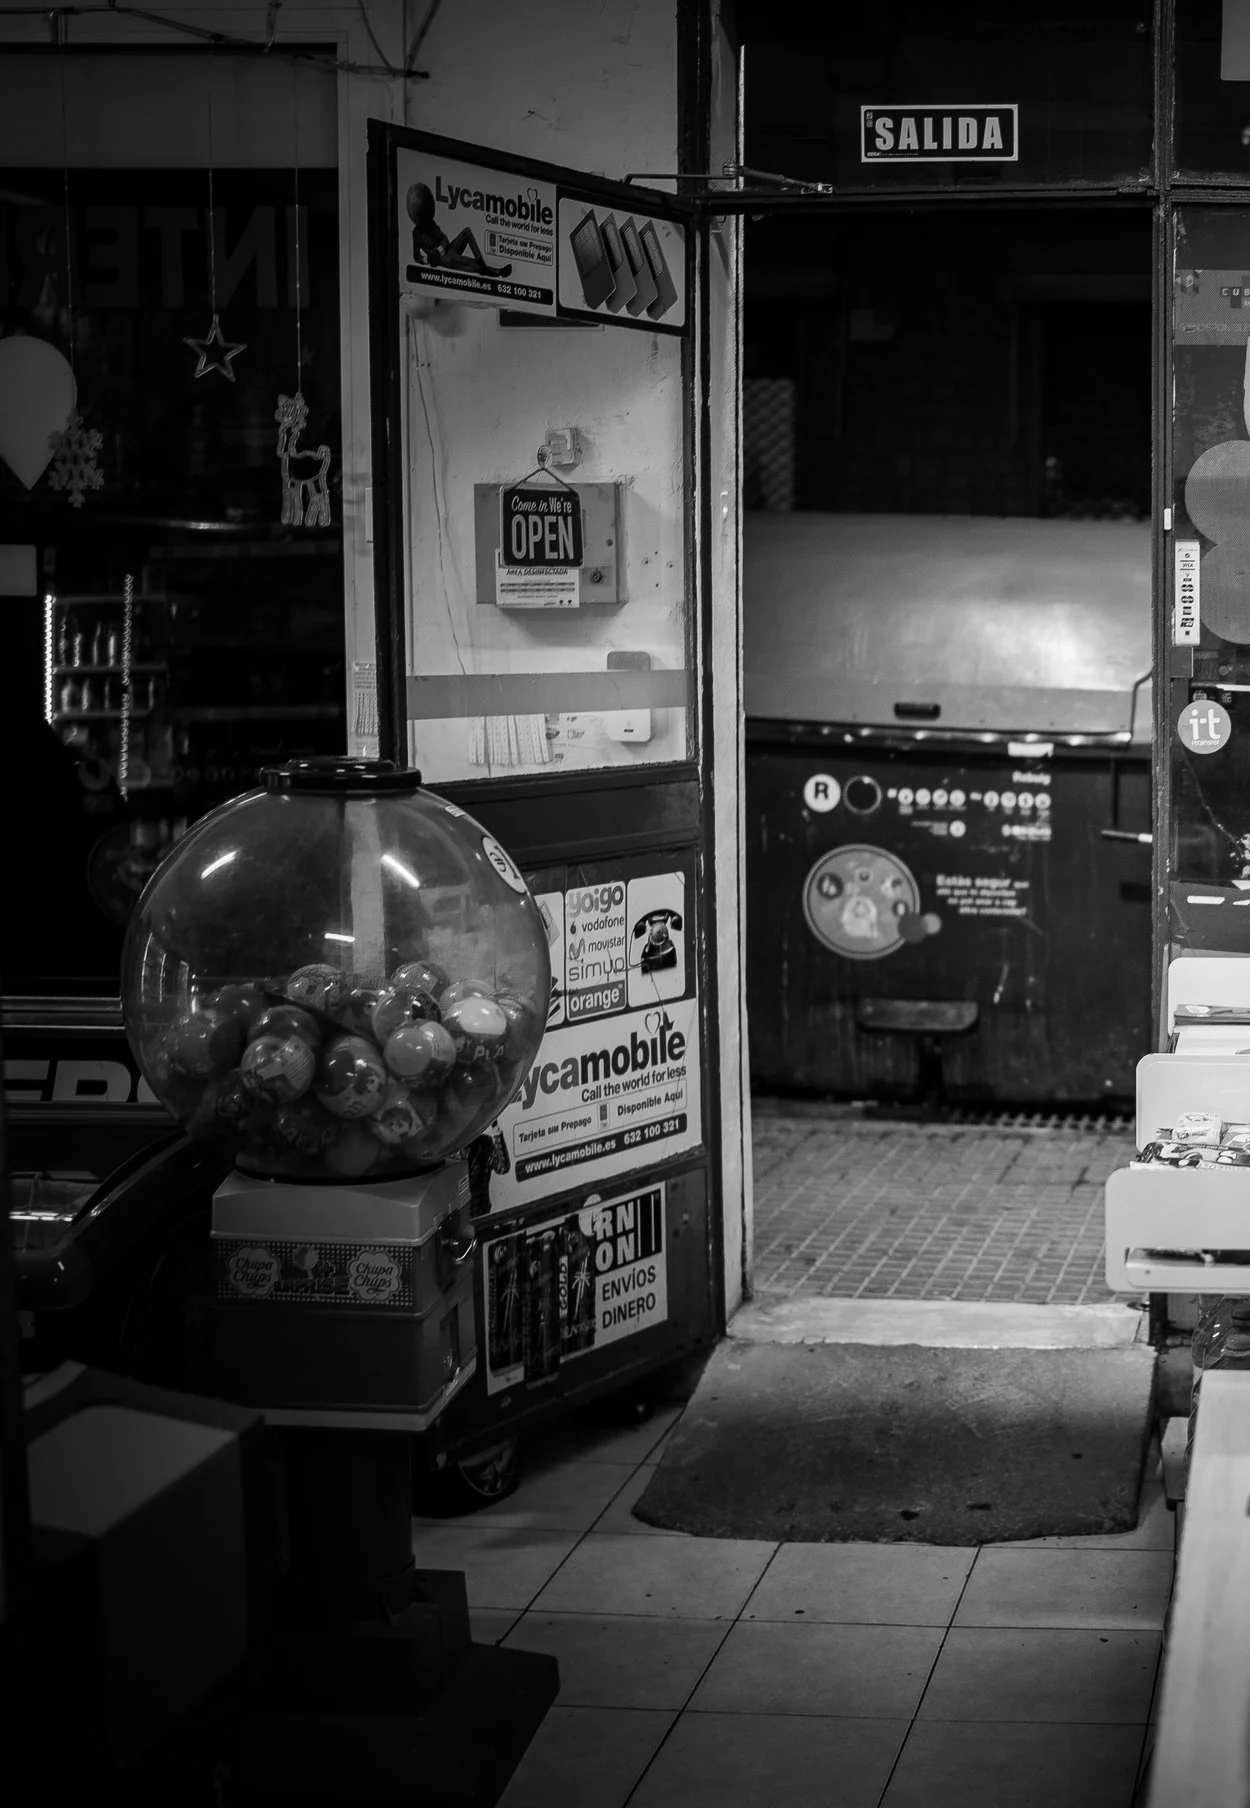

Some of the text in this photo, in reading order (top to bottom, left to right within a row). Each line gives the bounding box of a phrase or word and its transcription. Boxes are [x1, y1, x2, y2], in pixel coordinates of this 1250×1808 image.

[875, 116, 1003, 150] SALIDA
[435, 175, 553, 225] Lycamobile
[485, 214, 553, 236] Call the world for less
[499, 235, 518, 248] Tarjeta
[529, 241, 552, 254] Prepago
[499, 245, 535, 260] Disponible
[420, 271, 542, 300] www.lycamobile.es 632 100 321
[511, 495, 572, 513] Come in We're
[511, 514, 575, 560] OPEN
[814, 782, 829, 799] R
[568, 885, 624, 918] yoigo
[582, 916, 625, 933] vodafone
[588, 936, 626, 952] movistar
[568, 957, 625, 982] simyo
[570, 986, 620, 1012] orange
[511, 1025, 686, 1110] ycamobile
[581, 1065, 687, 1102] Call the world for less
[519, 1126, 545, 1143] Tarjeta
[561, 1116, 592, 1133] Prepago
[617, 1095, 661, 1116] Disponible
[525, 1118, 679, 1174] www.lycamobile.es 632 100 321
[235, 1258, 273, 1271] Chupa
[355, 1263, 393, 1276] Chupa
[233, 1269, 272, 1288] Chups
[354, 1274, 392, 1294] Chups
[559, 1262, 568, 1311] GOLD
[602, 1265, 656, 1301] ENVÍOS
[602, 1293, 656, 1329] DINERO
